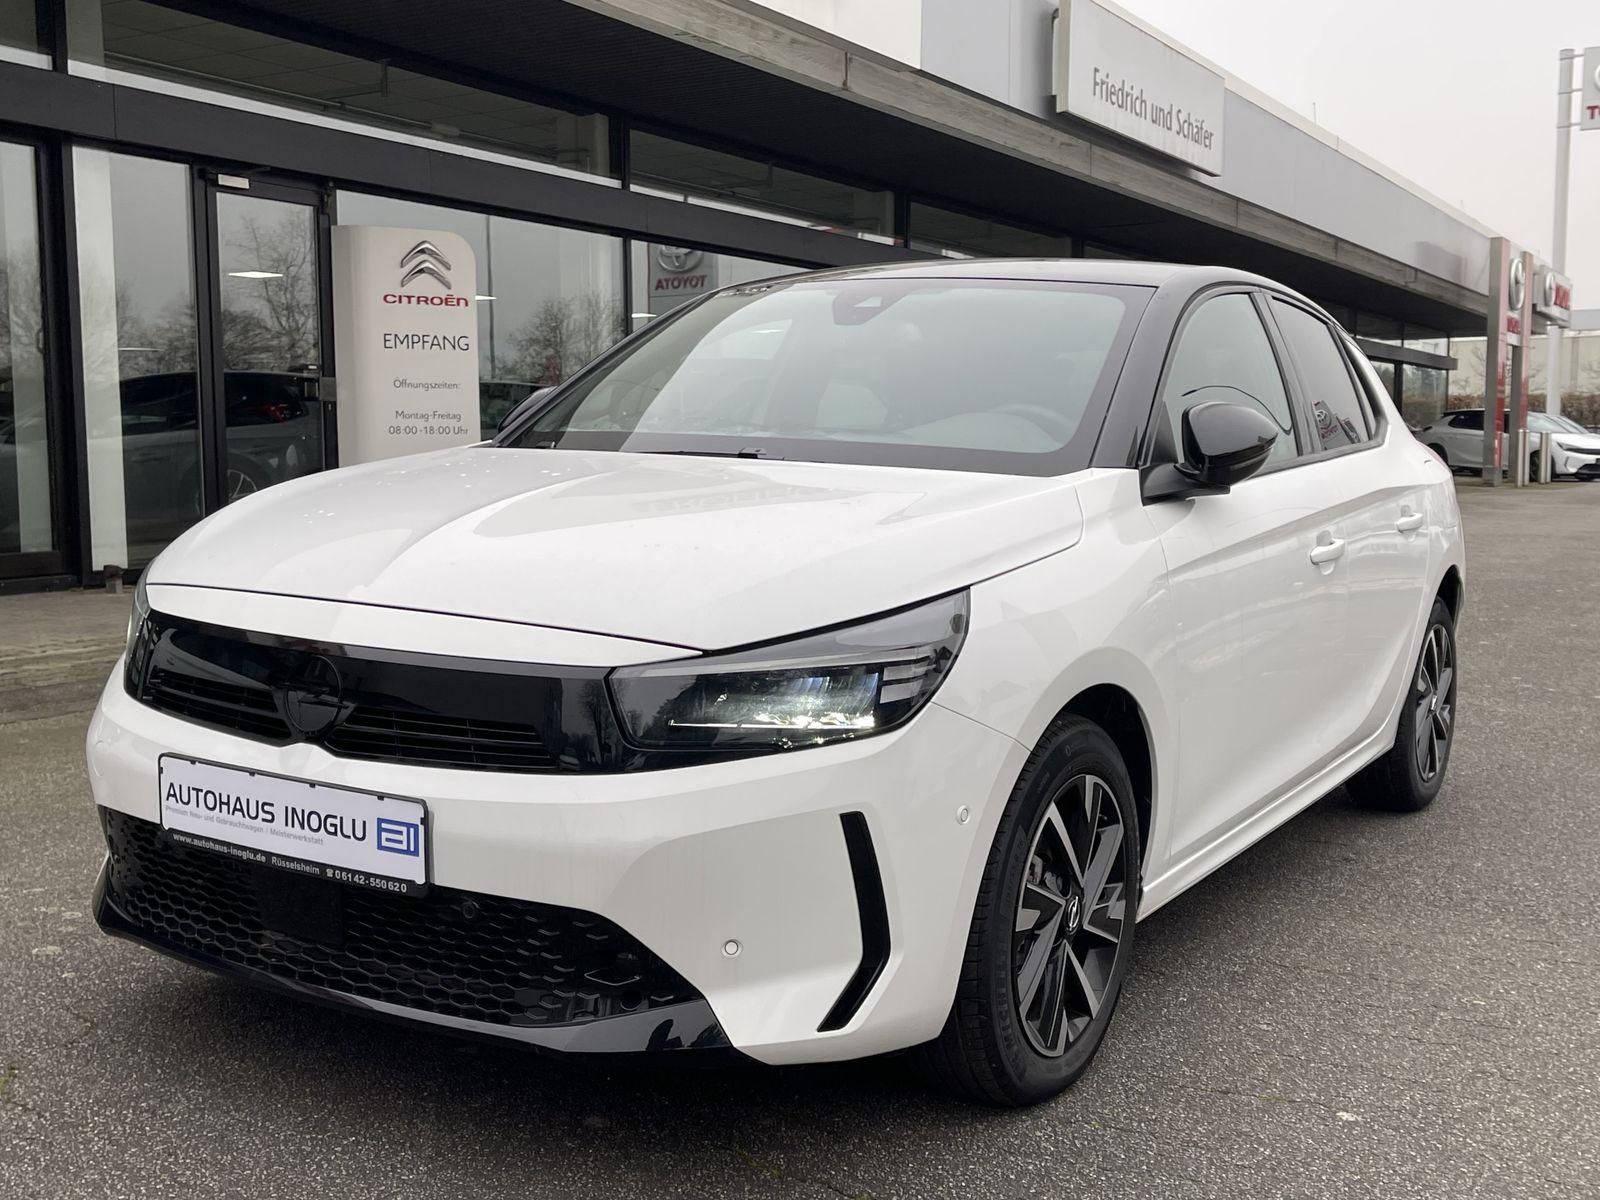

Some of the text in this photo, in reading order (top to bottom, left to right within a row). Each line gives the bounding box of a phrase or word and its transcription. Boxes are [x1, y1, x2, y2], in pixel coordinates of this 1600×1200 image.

[1092, 66, 1215, 151] Friedrich und Schäfer
[383, 332, 470, 352] EMPFANG
[453, 425, 469, 435] Uhr
[165, 781, 367, 842] AUTOHAUS INOGLU
[172, 833, 266, 863] www.autohaus-inoglu.de
[271, 856, 320, 875] Rüsselsheim
